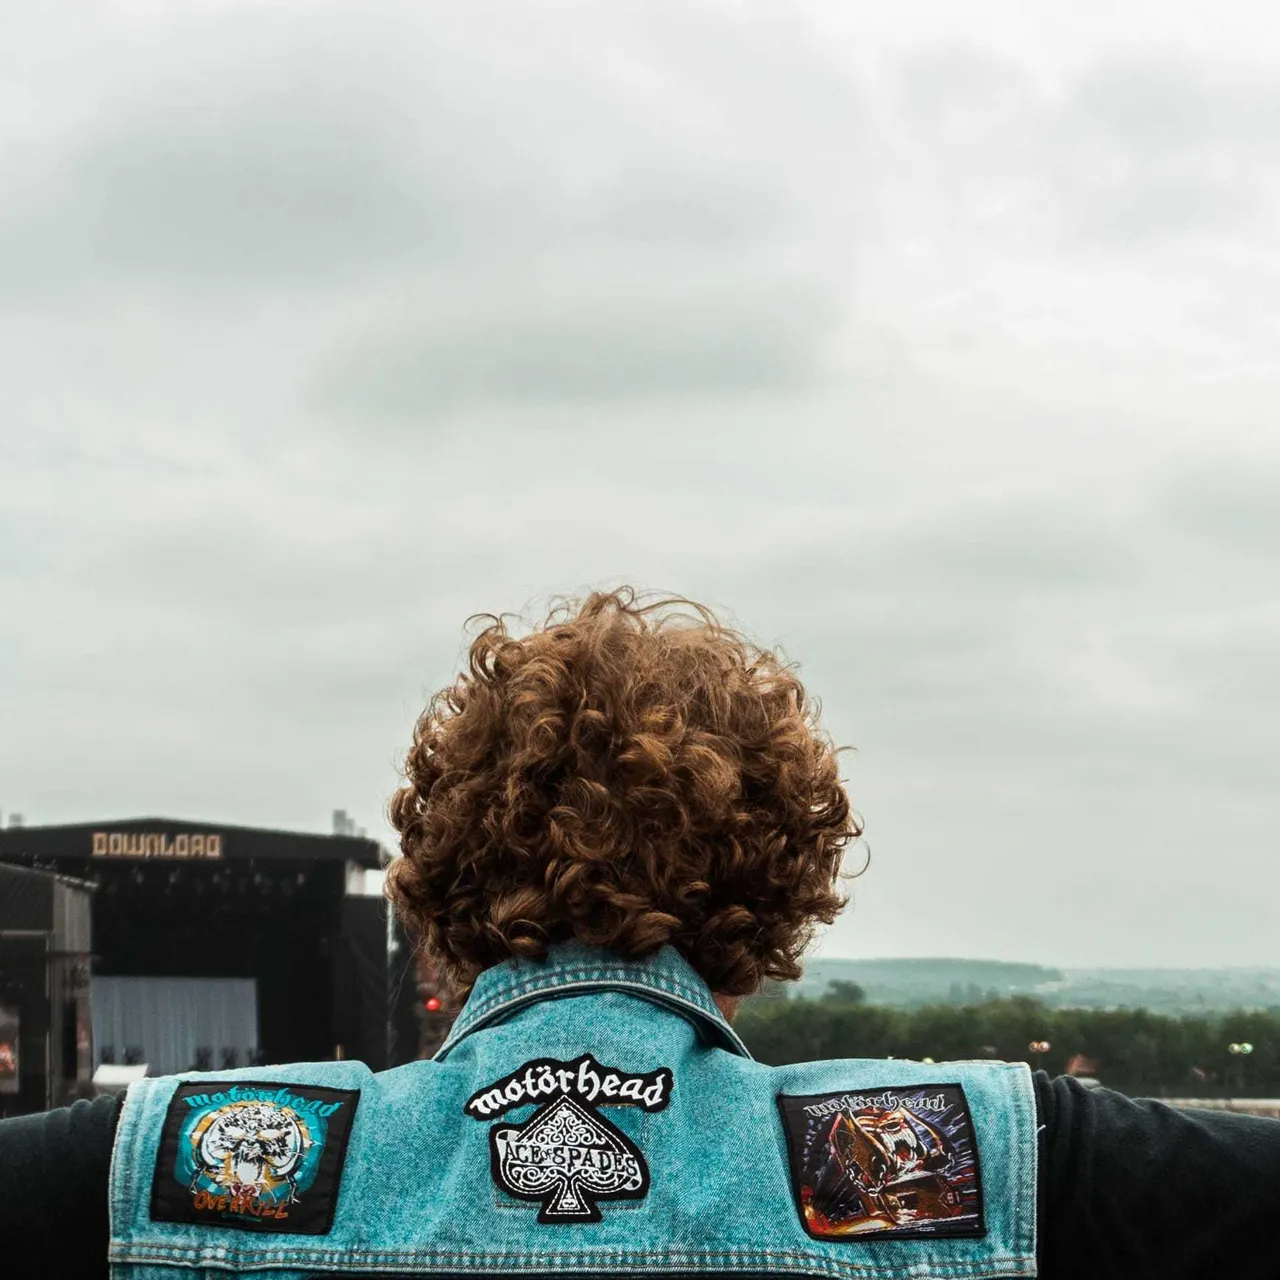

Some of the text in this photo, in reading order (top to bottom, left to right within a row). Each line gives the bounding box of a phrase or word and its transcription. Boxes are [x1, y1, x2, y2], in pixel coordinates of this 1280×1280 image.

[92, 832, 220, 857] DOWNLOAD
[470, 1056, 666, 1121] motörhead
[505, 1140, 541, 1164] ACE
[552, 1146, 638, 1177] SPADES
